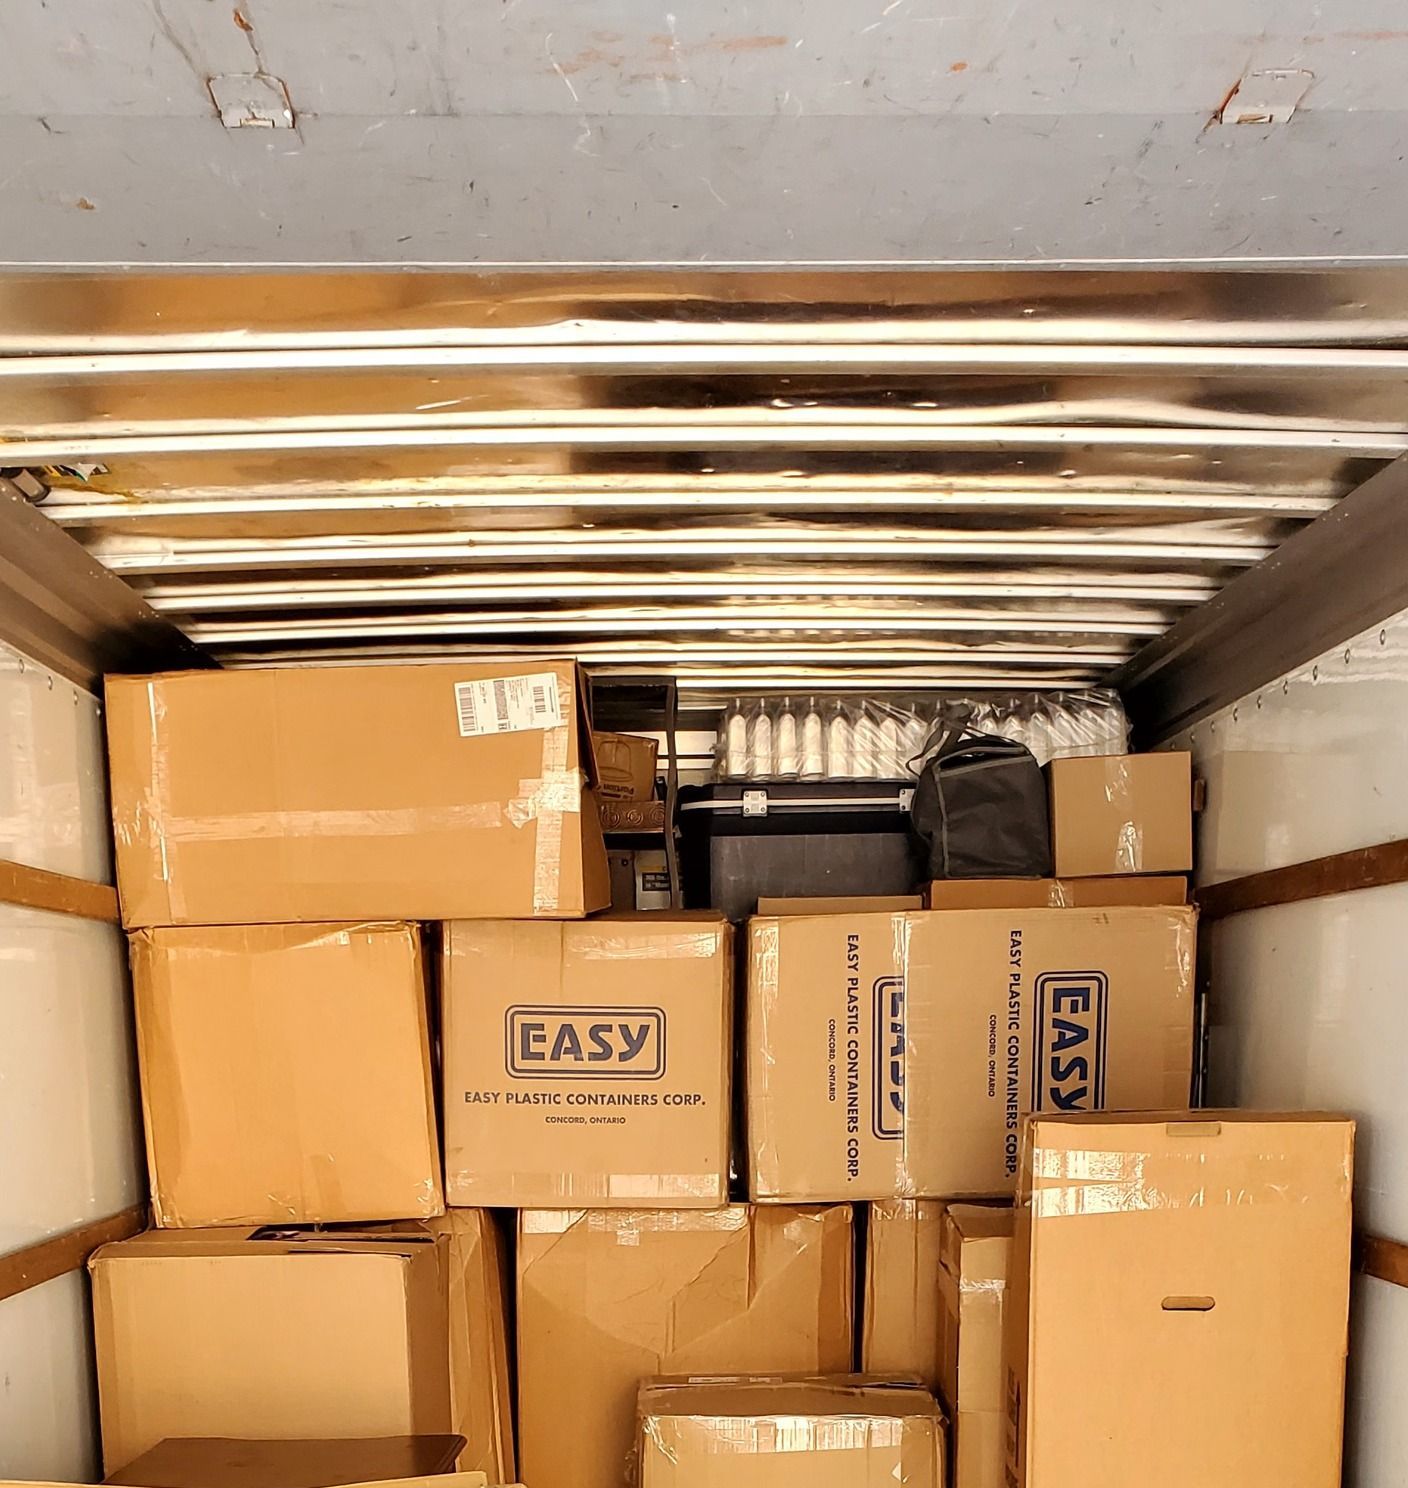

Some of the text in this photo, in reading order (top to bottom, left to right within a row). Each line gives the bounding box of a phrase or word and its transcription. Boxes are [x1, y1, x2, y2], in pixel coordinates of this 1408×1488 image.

[520, 1023, 650, 1062] EASY
[828, 1019, 836, 1101] CONCORD, ONTARIO
[847, 934, 859, 1181] EASY PLASTIC CONTAINERS CORP.
[987, 1014, 996, 1097] CONCORD, ONTARIO
[1004, 930, 1023, 1178] EASY PLASTIC CONTAINERS CORP.
[1050, 987, 1090, 1110] EASY
[464, 1091, 706, 1106] EASY PLASTIC CONTAINERS CORP.
[545, 1116, 626, 1125] CONCORD, ONTARIO
